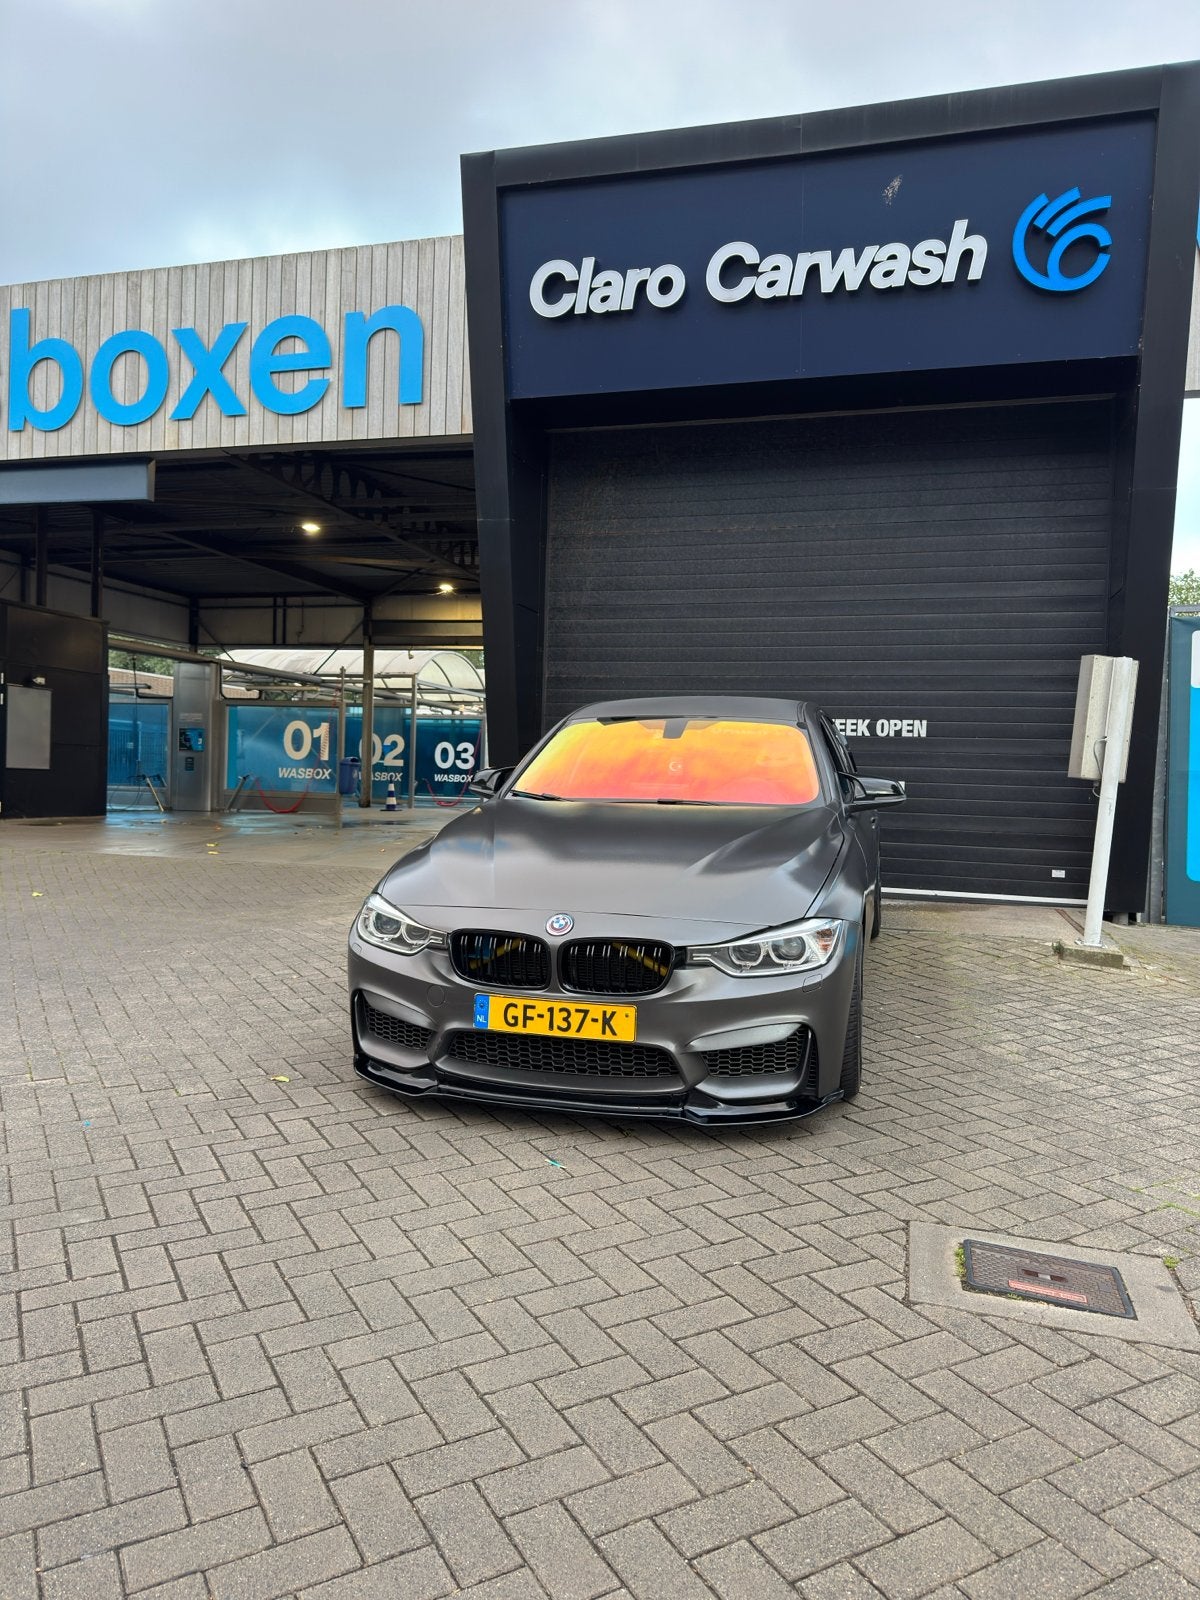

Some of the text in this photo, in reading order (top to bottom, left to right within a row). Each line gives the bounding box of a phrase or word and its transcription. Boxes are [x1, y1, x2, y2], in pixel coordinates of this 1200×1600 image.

[529, 219, 988, 318] Claro Carwash
[8, 305, 424, 432] boxen
[283, 720, 330, 761] 01
[832, 718, 928, 737] EEK OPEN
[358, 732, 405, 767] 02
[434, 741, 475, 770] 03
[278, 767, 332, 780] WASBOX
[358, 771, 403, 782] SBOX
[434, 773, 474, 783] WASBOX
[476, 1014, 487, 1023] NL
[503, 1002, 618, 1036] GF-137-K
